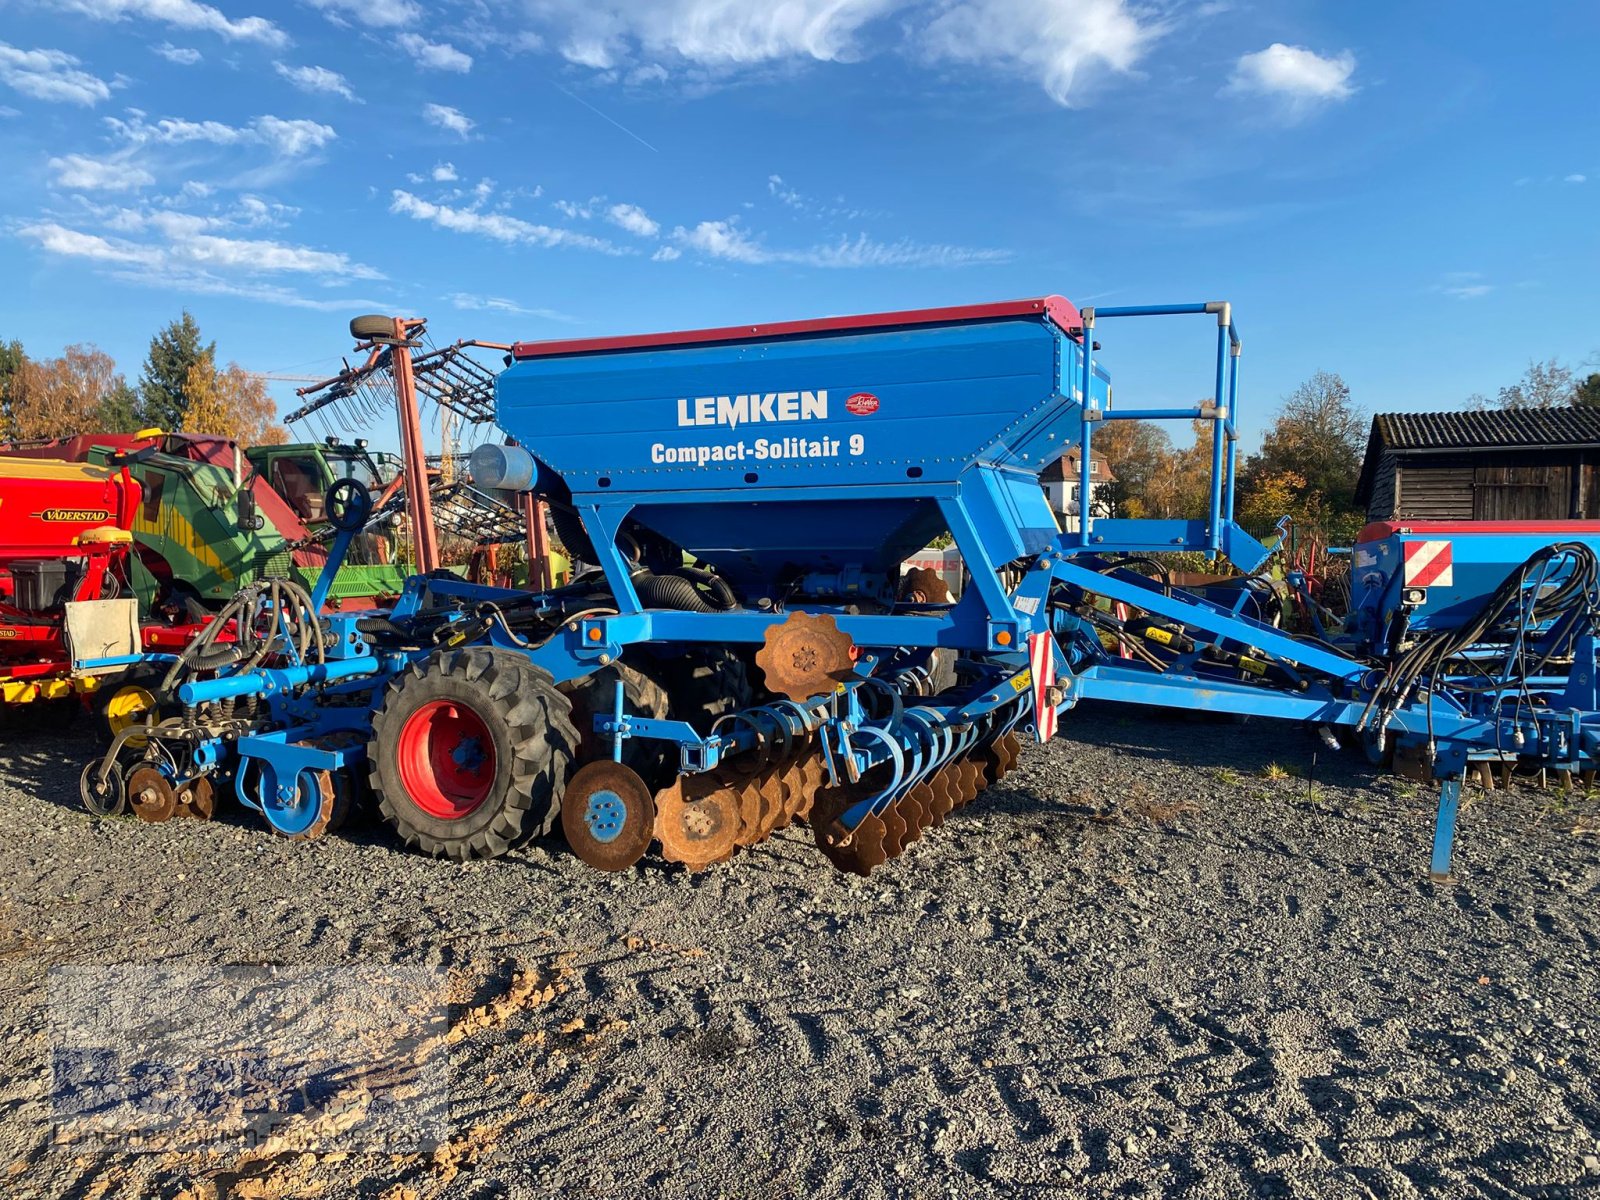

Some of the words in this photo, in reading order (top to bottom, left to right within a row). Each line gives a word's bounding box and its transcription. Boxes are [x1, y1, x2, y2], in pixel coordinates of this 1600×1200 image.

[677, 390, 828, 431] LEMKEN
[651, 436, 841, 467] Compact-Solitair
[849, 433, 865, 456] 9
[46, 509, 106, 521] VÄDERSTAD
